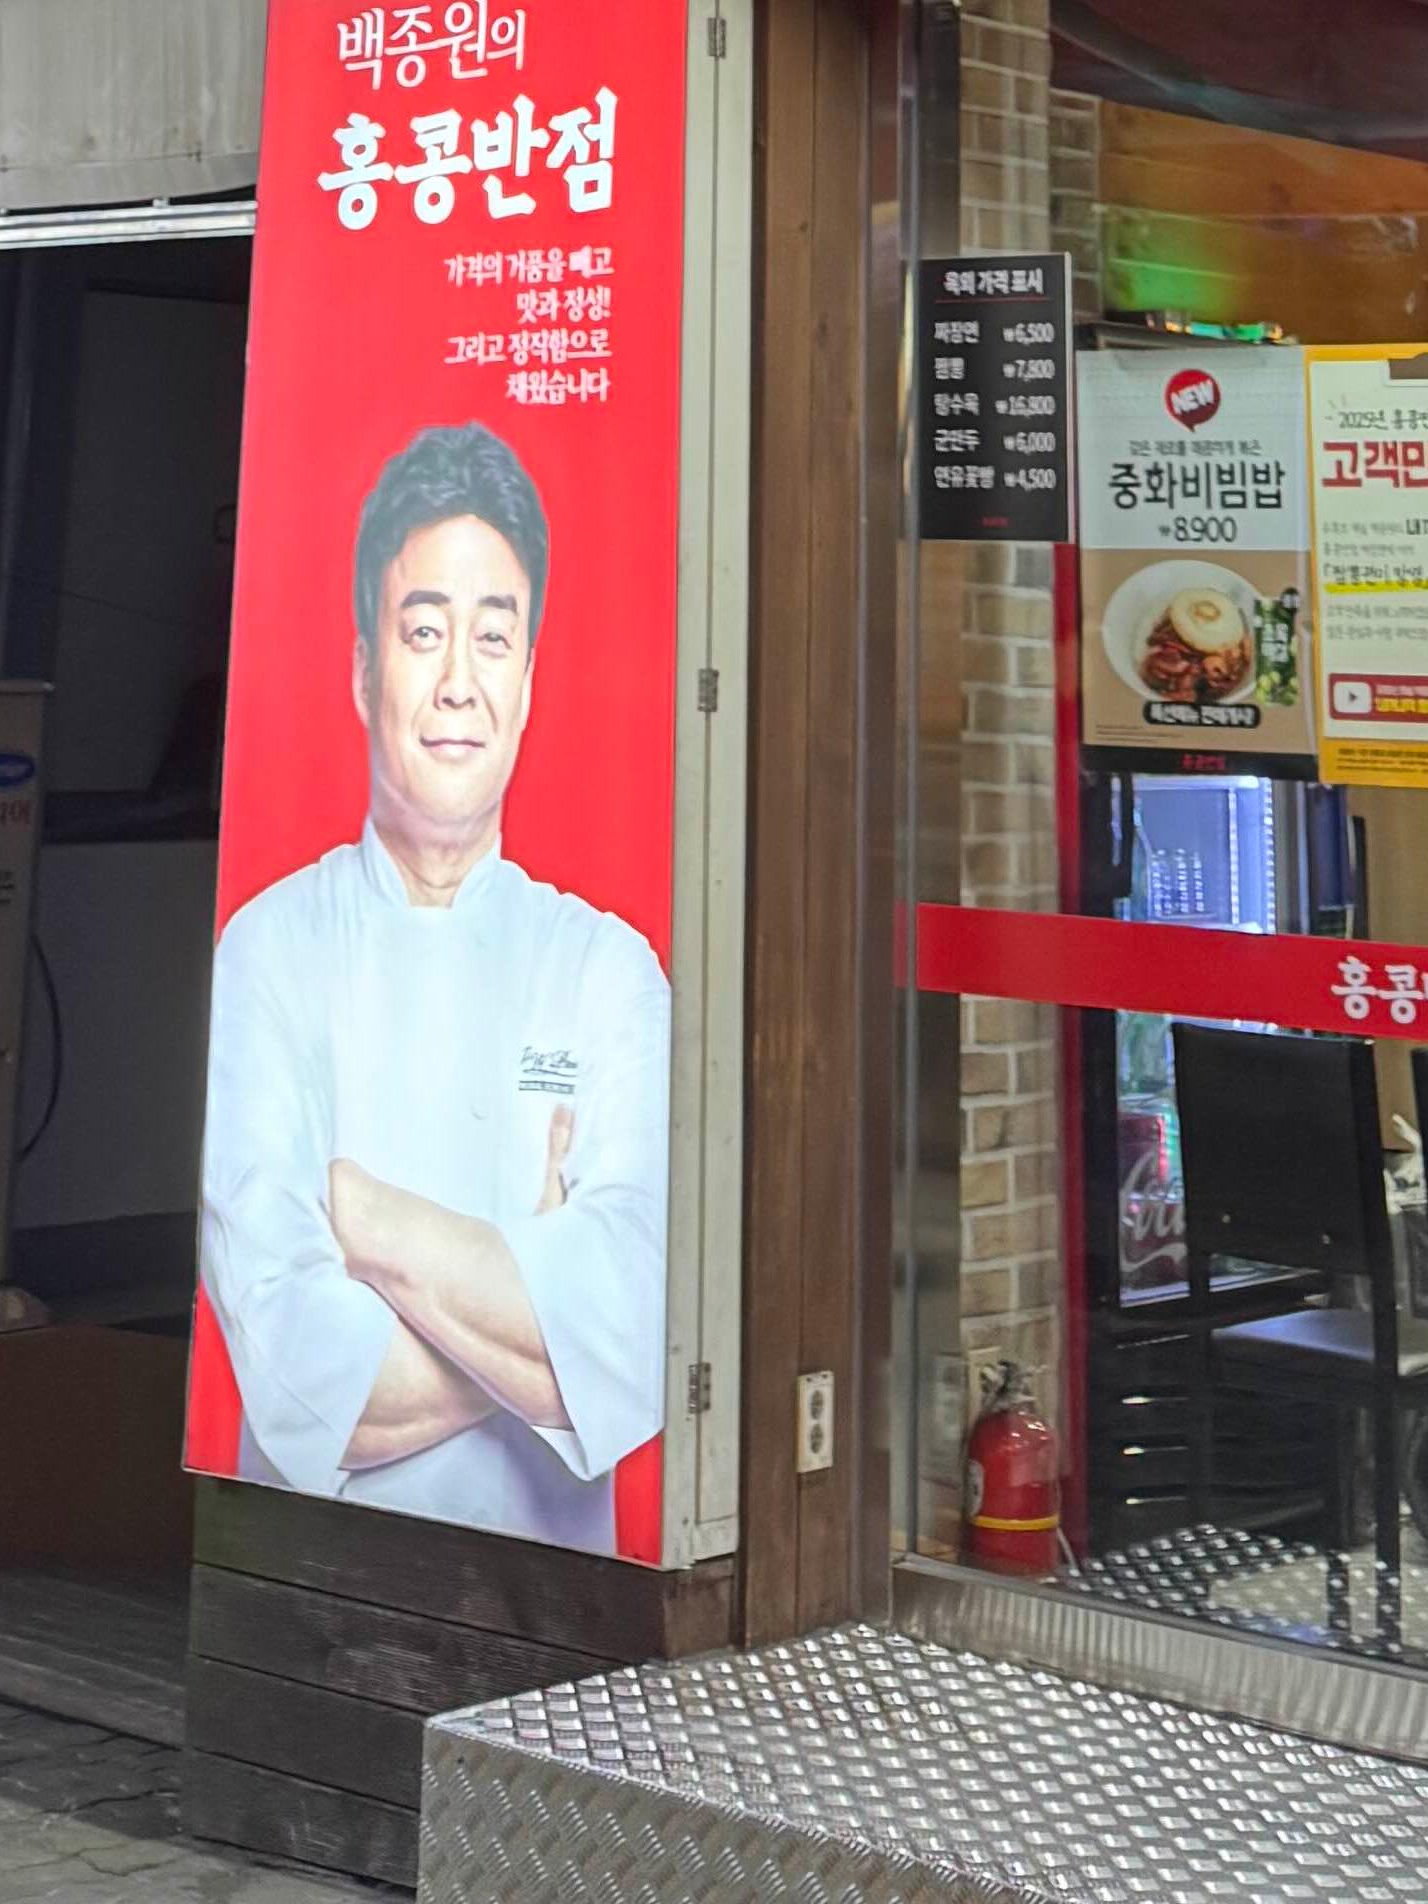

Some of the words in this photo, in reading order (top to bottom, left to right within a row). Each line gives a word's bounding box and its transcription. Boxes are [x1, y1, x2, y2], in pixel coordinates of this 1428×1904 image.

[316, 86, 619, 231] 홍콩반점
[443, 251, 503, 288] 가격의
[505, 247, 567, 284] 거품을
[977, 269, 1010, 295] 가격
[516, 288, 562, 324] 맛과
[563, 284, 612, 323] 정성!
[443, 331, 508, 367] 그리고
[507, 326, 613, 367] 정직함으로
[505, 366, 612, 405] 채웠습니다
[1169, 379, 1215, 416] NEW
[1109, 460, 1286, 510] 중화비빔밥
